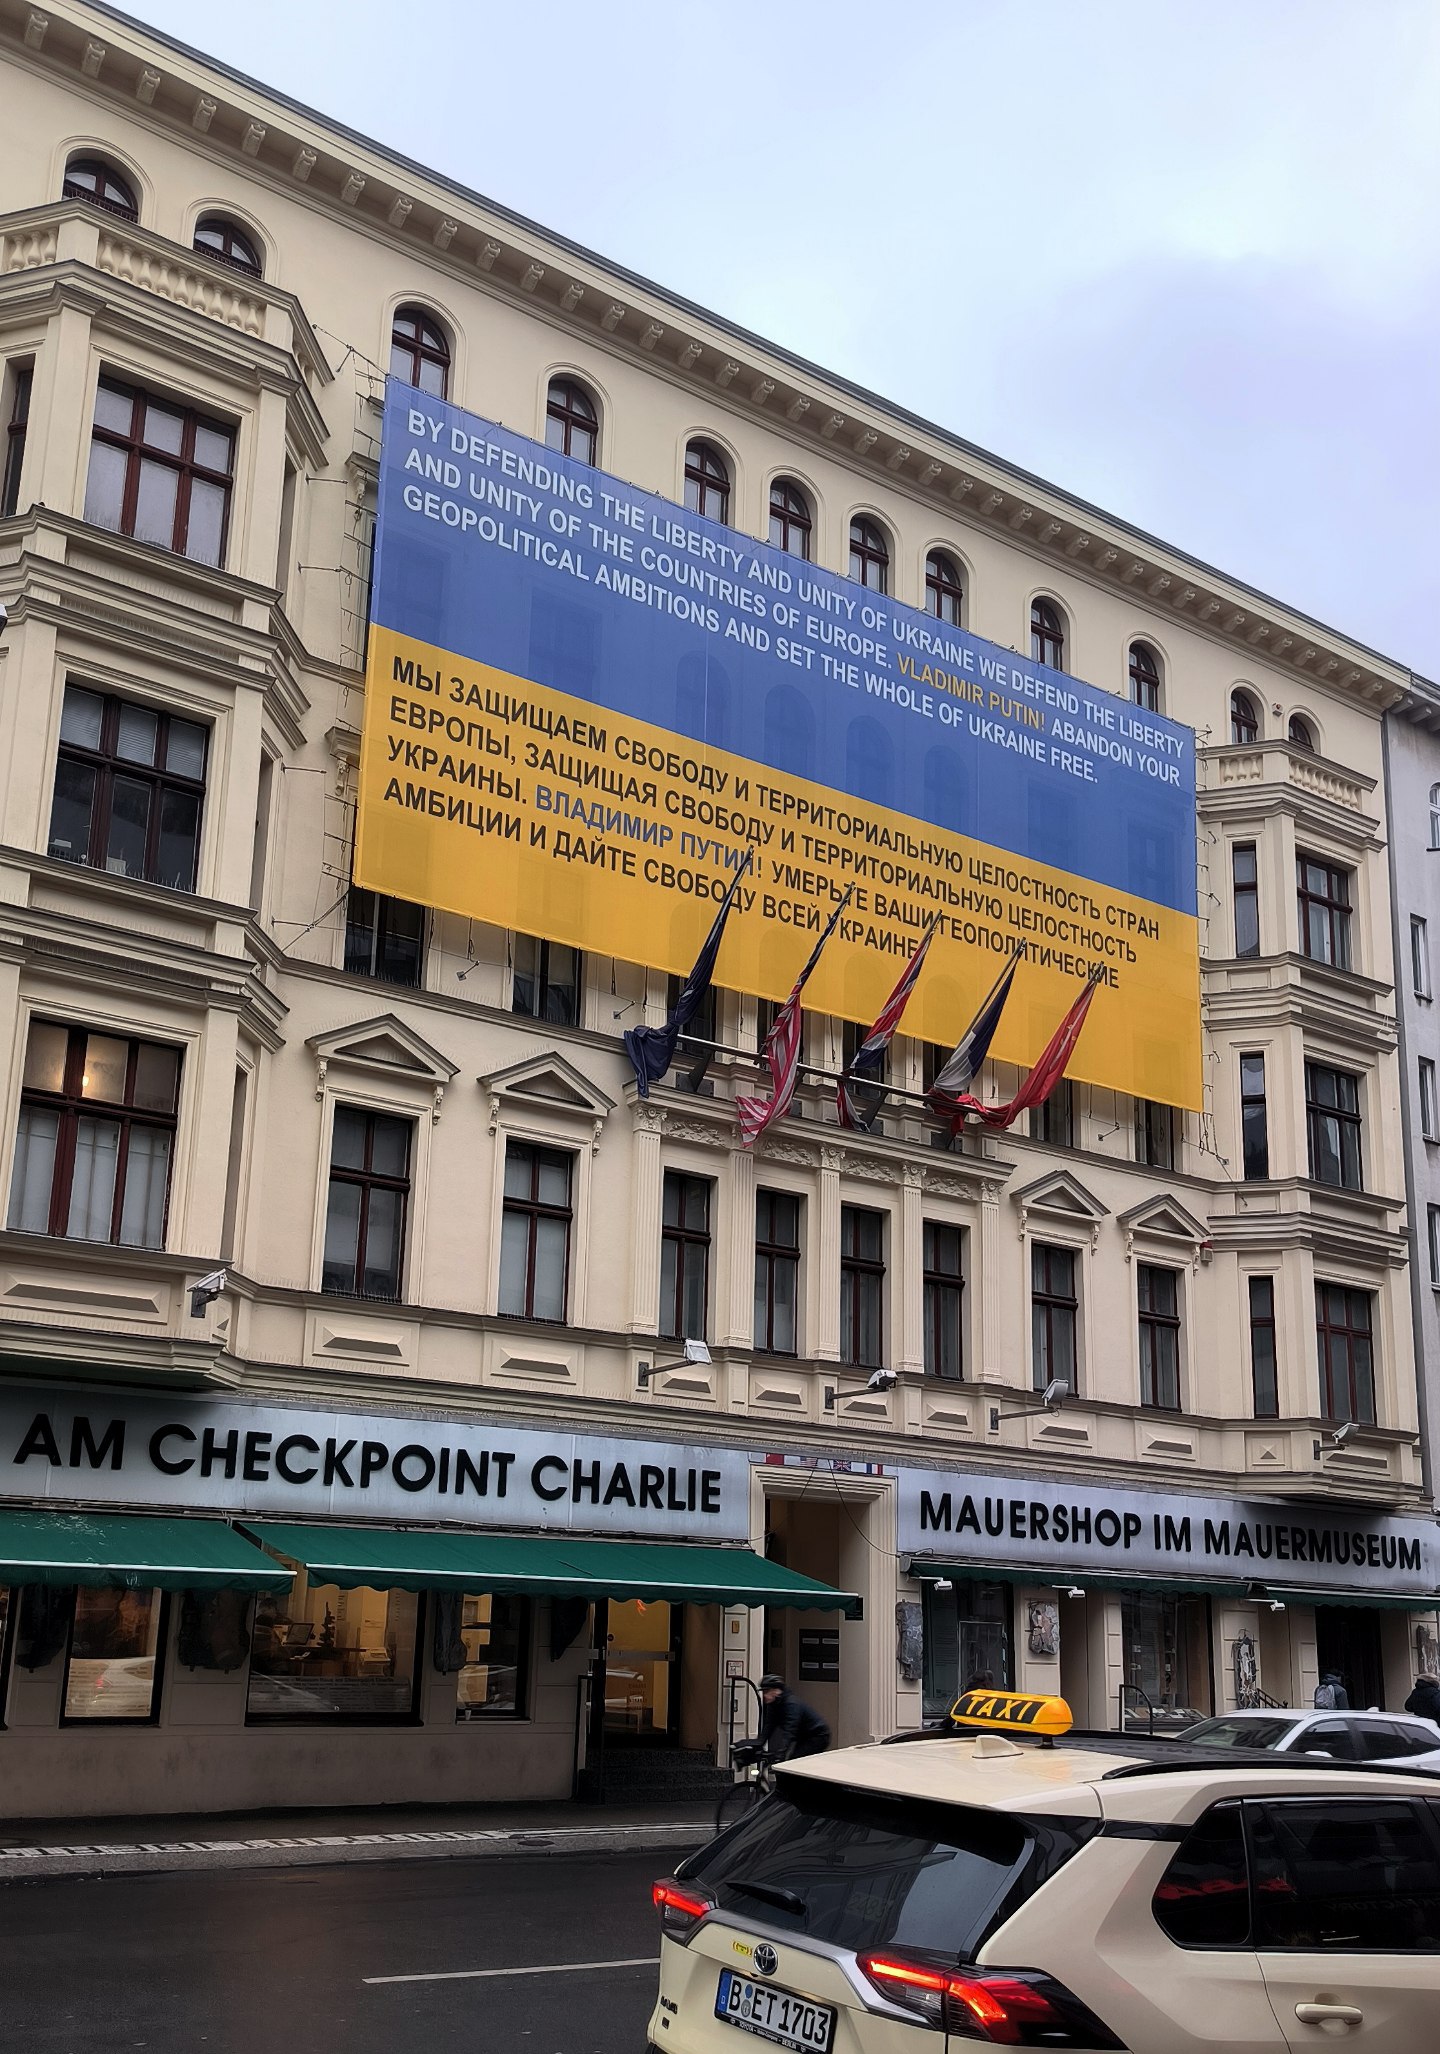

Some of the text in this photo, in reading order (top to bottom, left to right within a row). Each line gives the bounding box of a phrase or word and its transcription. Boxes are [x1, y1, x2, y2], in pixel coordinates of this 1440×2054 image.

[403, 484, 1098, 784] GEOPOLITICAL AMBITIONS AND SET THE WHOLE OF UKRAINE FREE.
[404, 448, 1181, 787] AND UNITY OF THE COUNTRIES OF EUROPE. VLADIMIR PUTIN! ABANDON YOUR
[408, 408, 1184, 759] BY DEFENDING THE LIBERTY AND UNITY OF UKRAINE WE DEFEND THE LIBERTY
[383, 778, 522, 843] АМБИЦИИ
[529, 821, 547, 850] И
[552, 830, 638, 878] ДАЙТЕ
[643, 858, 757, 913] СВОБОДУ
[762, 893, 821, 932] ВСЕЙ
[387, 735, 527, 805] УКРАИНЫ.
[535, 784, 674, 849] ВЛАДИМИР
[680, 831, 763, 878] ПУТИН!
[873, 893, 934, 932] ВАШИ
[389, 696, 1138, 964] ЕВРОПЫ, ЗАЩИЩАЯ СВОБОДУ И ТЕРРИТОРИАЛЬНУЮ ЦЕЛОСТНОСТЬ
[392, 656, 1159, 941] МЫ ЗАЩИЩАЕМ СВОБОДУ И ТЕРРИТОРИАЛЬНУЮ ЦЕЛОСТНОСТЬ СТРАН
[14, 1413, 722, 1514] AM CHECKPOINT CHARLIE
[920, 1490, 1422, 1571] MAUERSHOP IM MAUERMUSEUM
[965, 1694, 1034, 1721] TAXI
